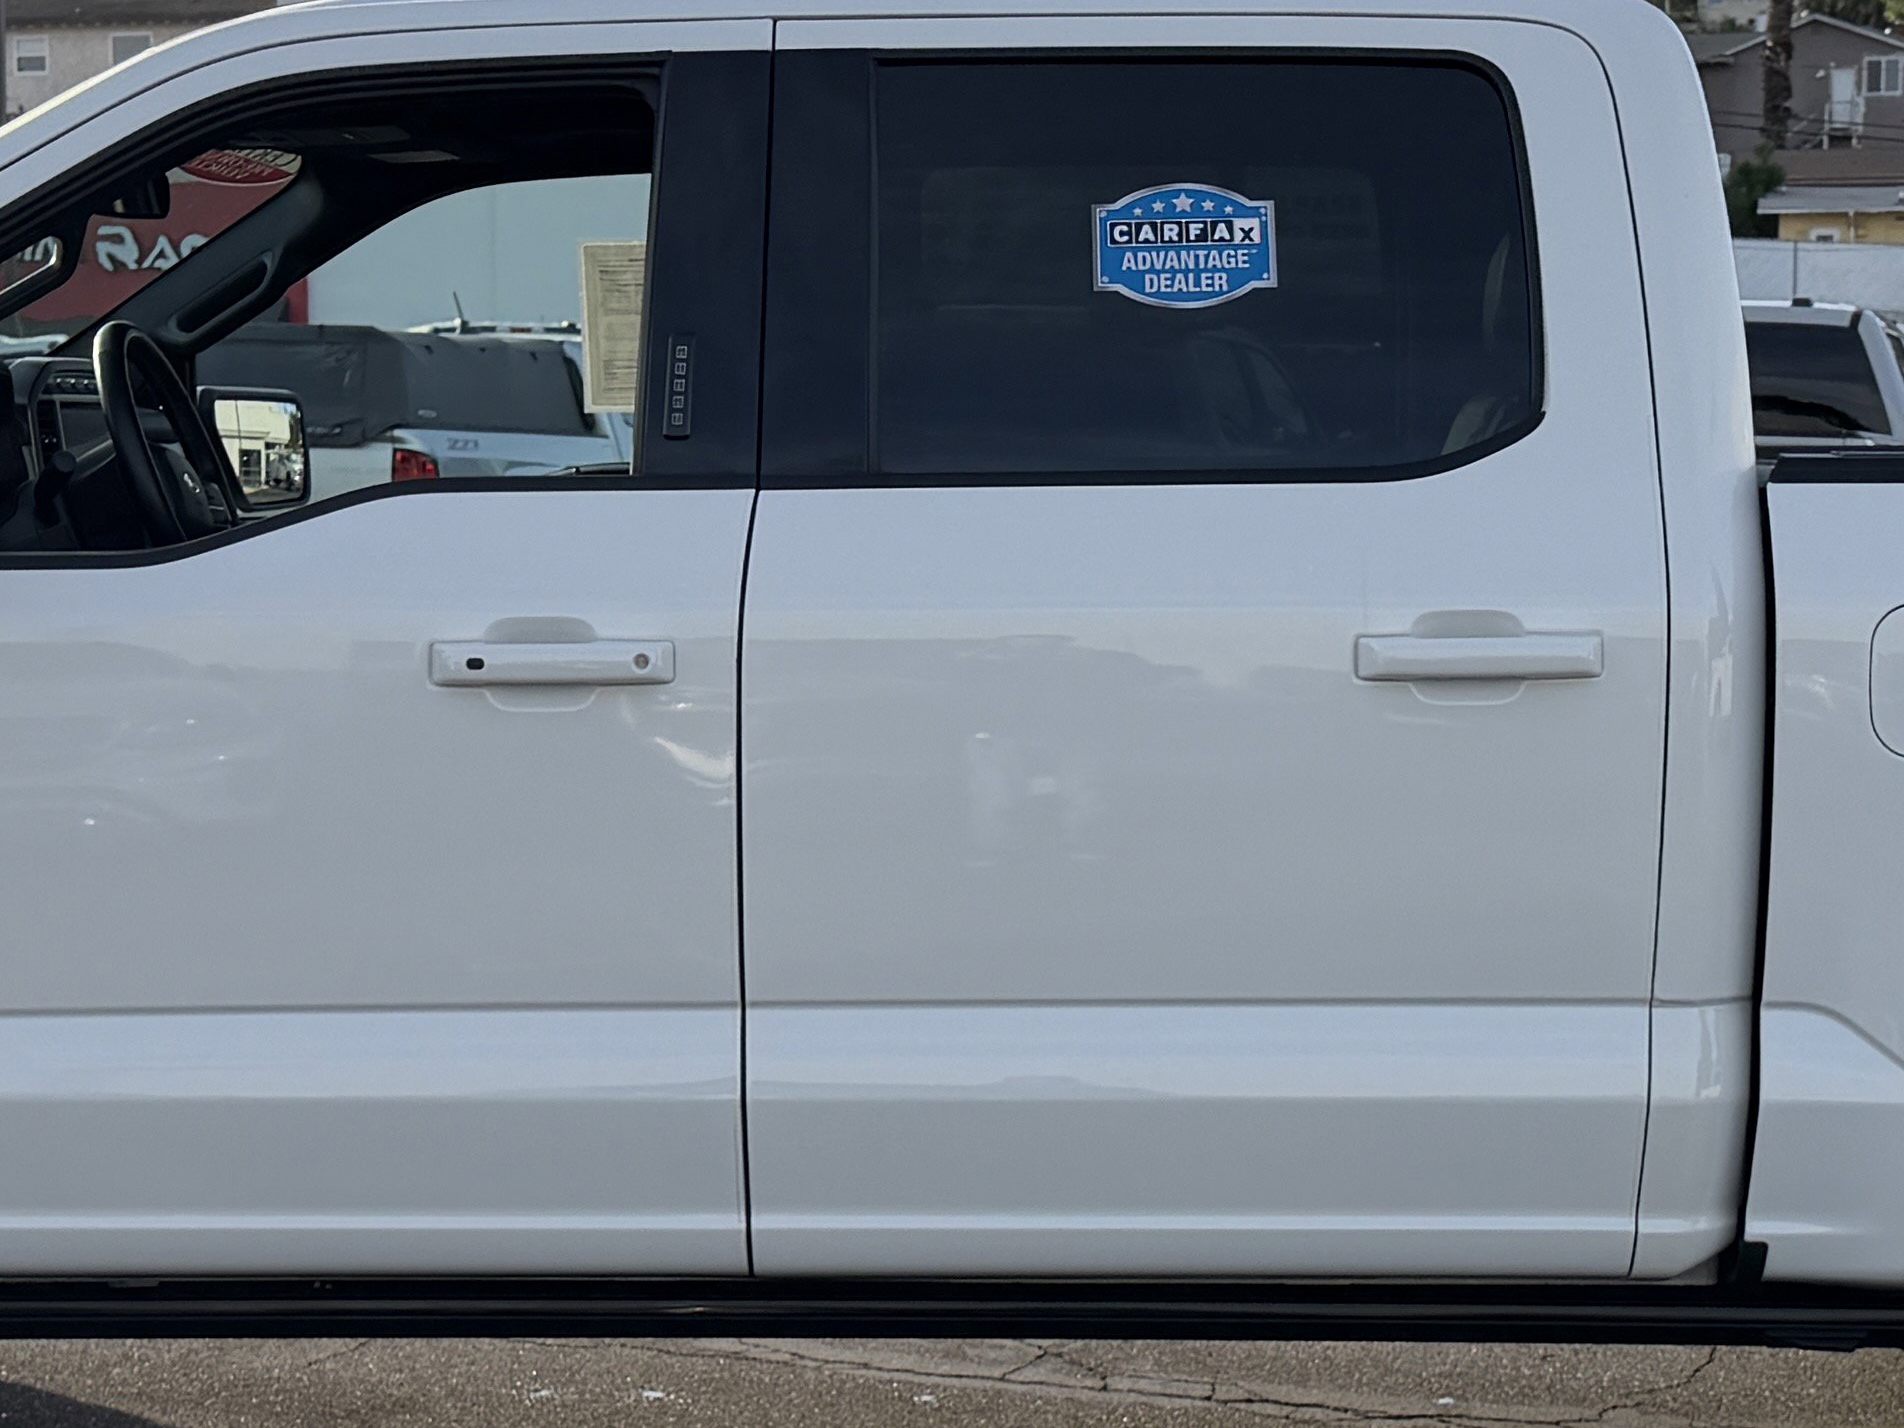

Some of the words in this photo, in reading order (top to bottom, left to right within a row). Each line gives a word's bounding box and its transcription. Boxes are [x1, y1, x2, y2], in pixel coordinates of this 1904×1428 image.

[1112, 222, 1256, 243] CARFAX
[1122, 249, 1251, 270] ADVANTAGE
[1144, 272, 1229, 293] DEALER
